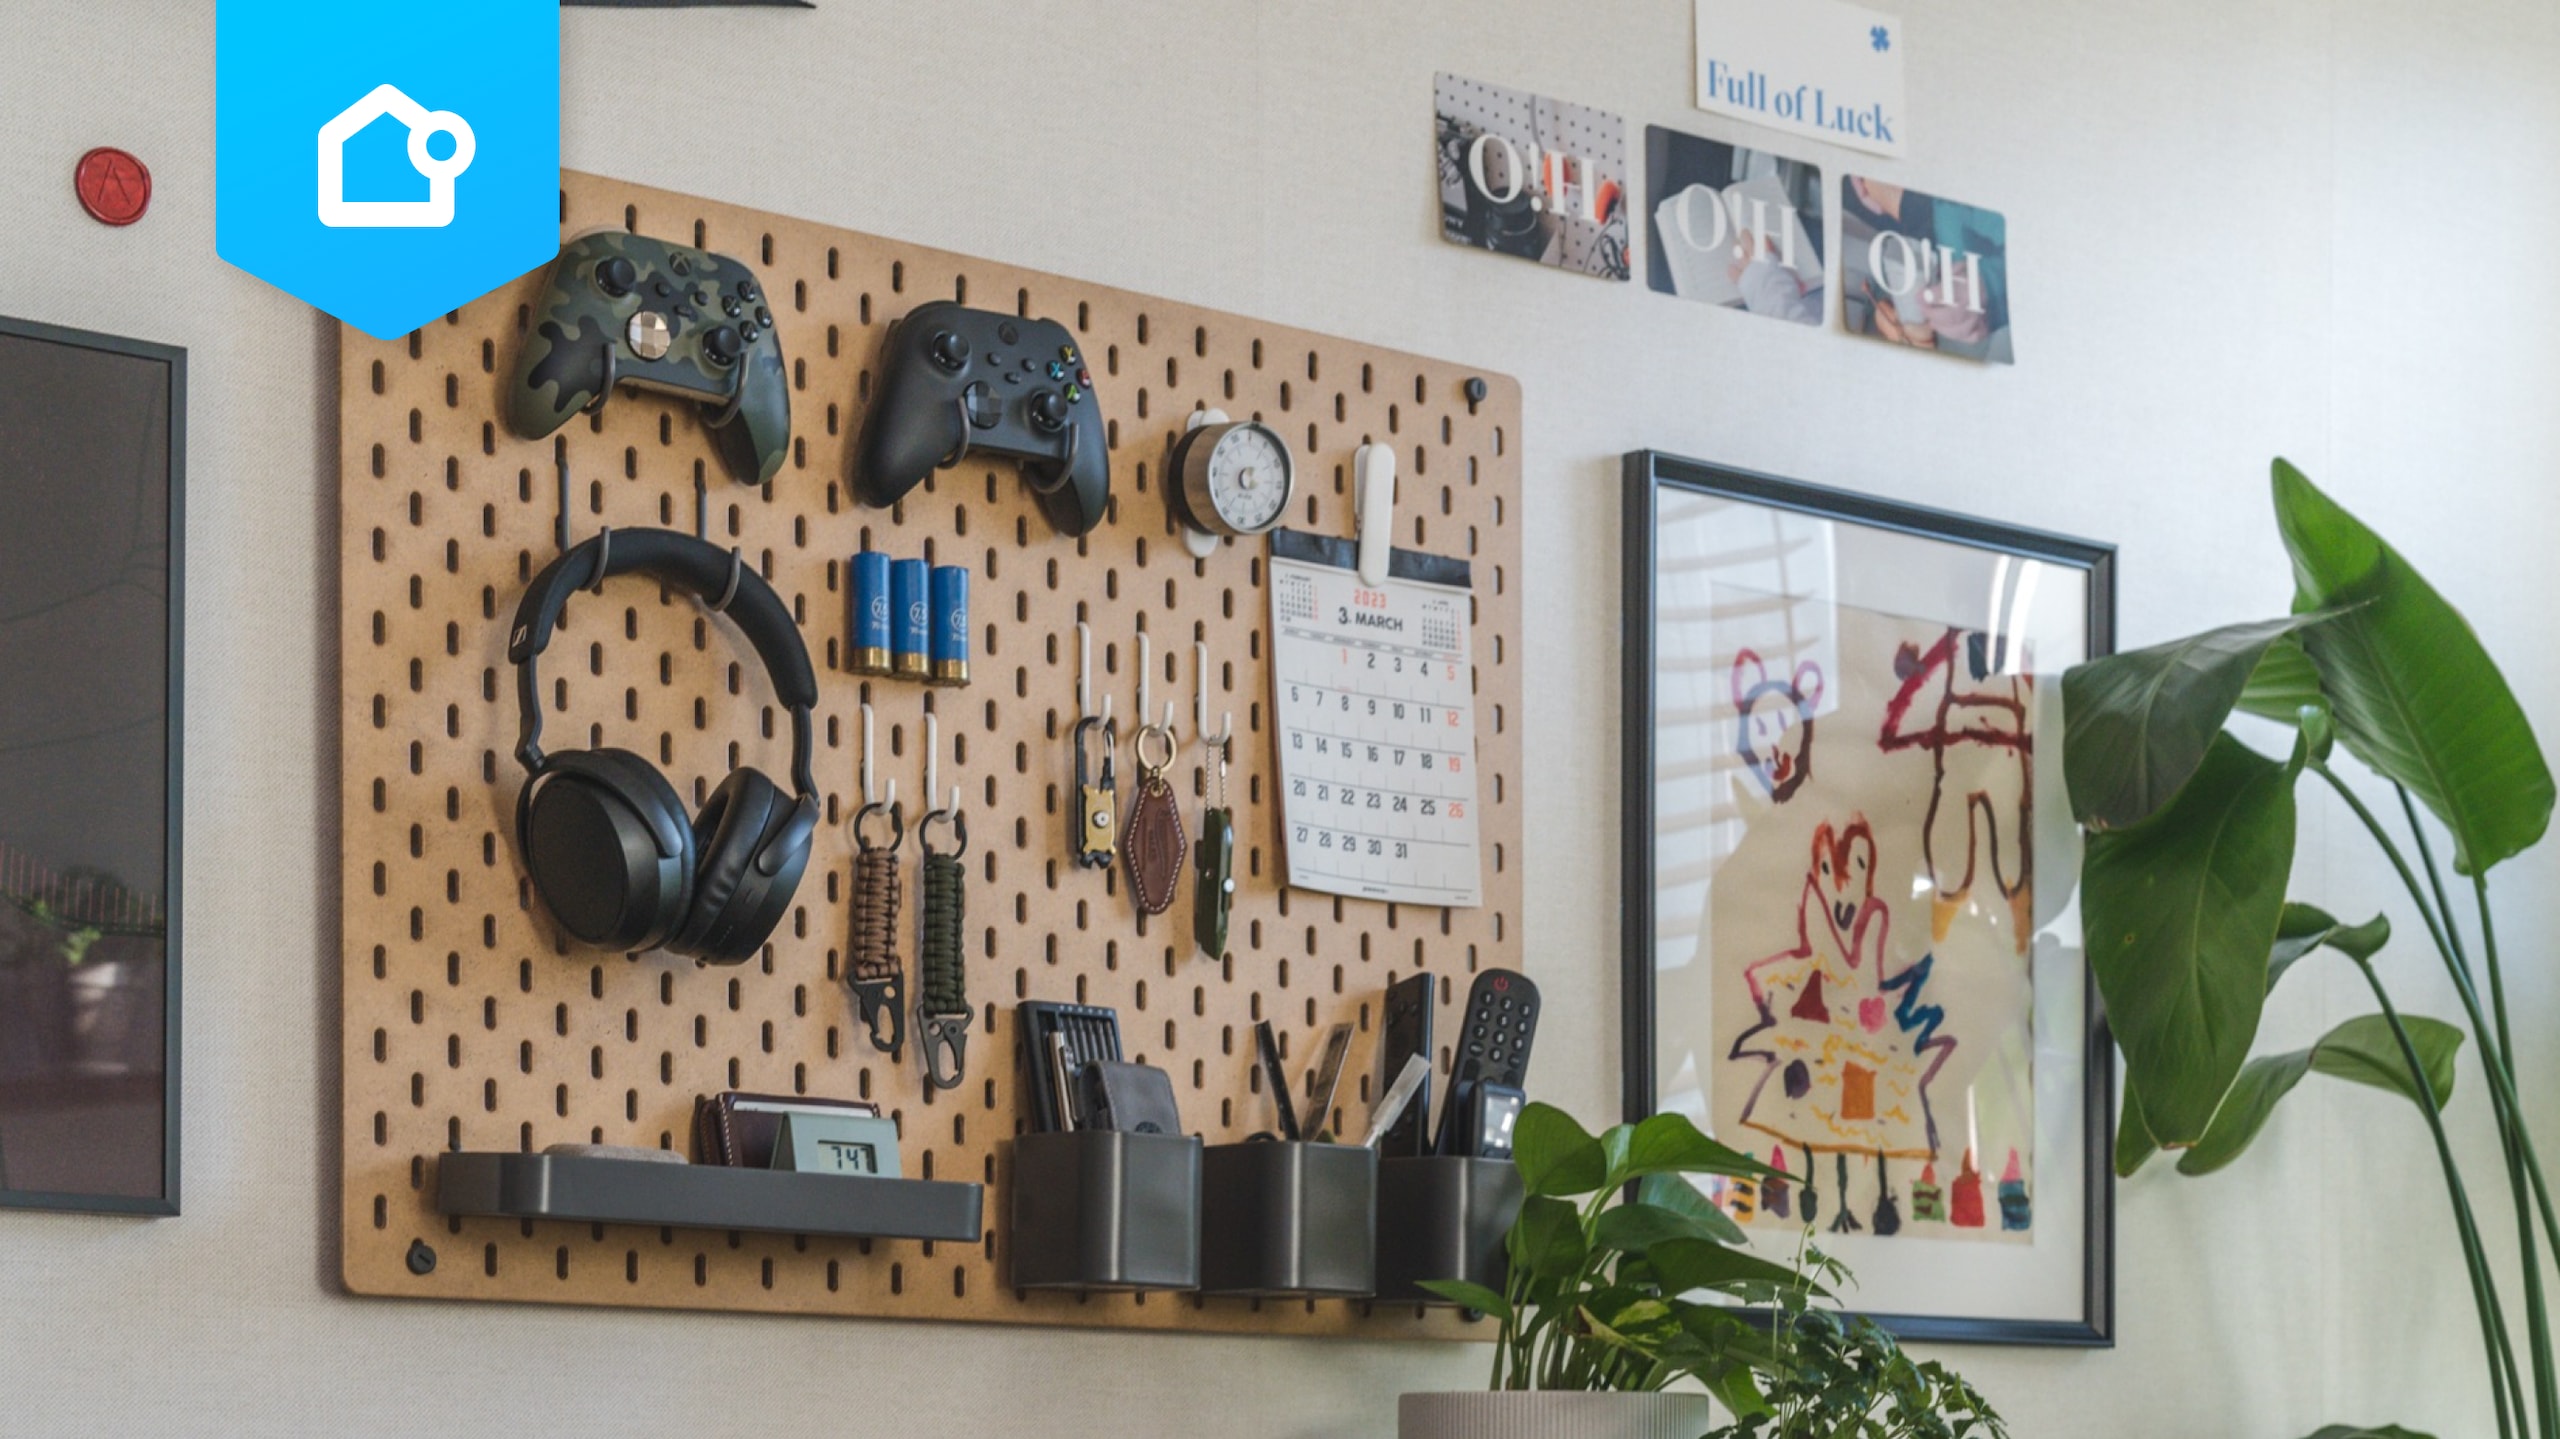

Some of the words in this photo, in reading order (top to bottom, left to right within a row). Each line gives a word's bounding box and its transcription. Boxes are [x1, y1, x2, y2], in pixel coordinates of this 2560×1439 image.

[1708, 59, 1766, 111] Full
[1775, 85, 1807, 121] of
[1815, 90, 1894, 143] Luck
[1468, 133, 1599, 222] O!H
[1676, 183, 1797, 269] O!H
[1868, 230, 1985, 314] O!H
[1354, 588, 1386, 609] 2023
[1355, 612, 1403, 631] MARCH
[1367, 652, 1375, 669] 2
[1394, 657, 1401, 672] 3
[1420, 662, 1428, 676] 4
[1447, 665, 1455, 682] 5
[1291, 686, 1299, 702] 6
[1316, 690, 1323, 706] 7
[1341, 695, 1349, 711] 8
[1368, 699, 1376, 715] 9
[1393, 703, 1404, 720] 10
[1420, 707, 1431, 723] 11
[1447, 710, 1459, 727] 12
[1292, 732, 1303, 750] 13
[1316, 737, 1327, 754] 14
[1341, 741, 1352, 759] 15
[1367, 745, 1378, 762] 16
[1394, 749, 1405, 766] 17
[1421, 753, 1432, 770] 18
[1448, 757, 1460, 773] 19
[1293, 779, 1306, 797] 20
[1318, 784, 1328, 801] 21
[1341, 788, 1355, 806] 22
[1367, 792, 1381, 809] 23
[1393, 796, 1407, 812] 24
[1421, 799, 1436, 816] 25
[1448, 803, 1463, 819] 26
[1296, 826, 1308, 843] 27
[1319, 831, 1332, 848] 28
[1342, 835, 1356, 852] 29
[1368, 839, 1382, 856] 30
[1395, 842, 1407, 859] 31
[1504, 999, 1511, 1009] 2
